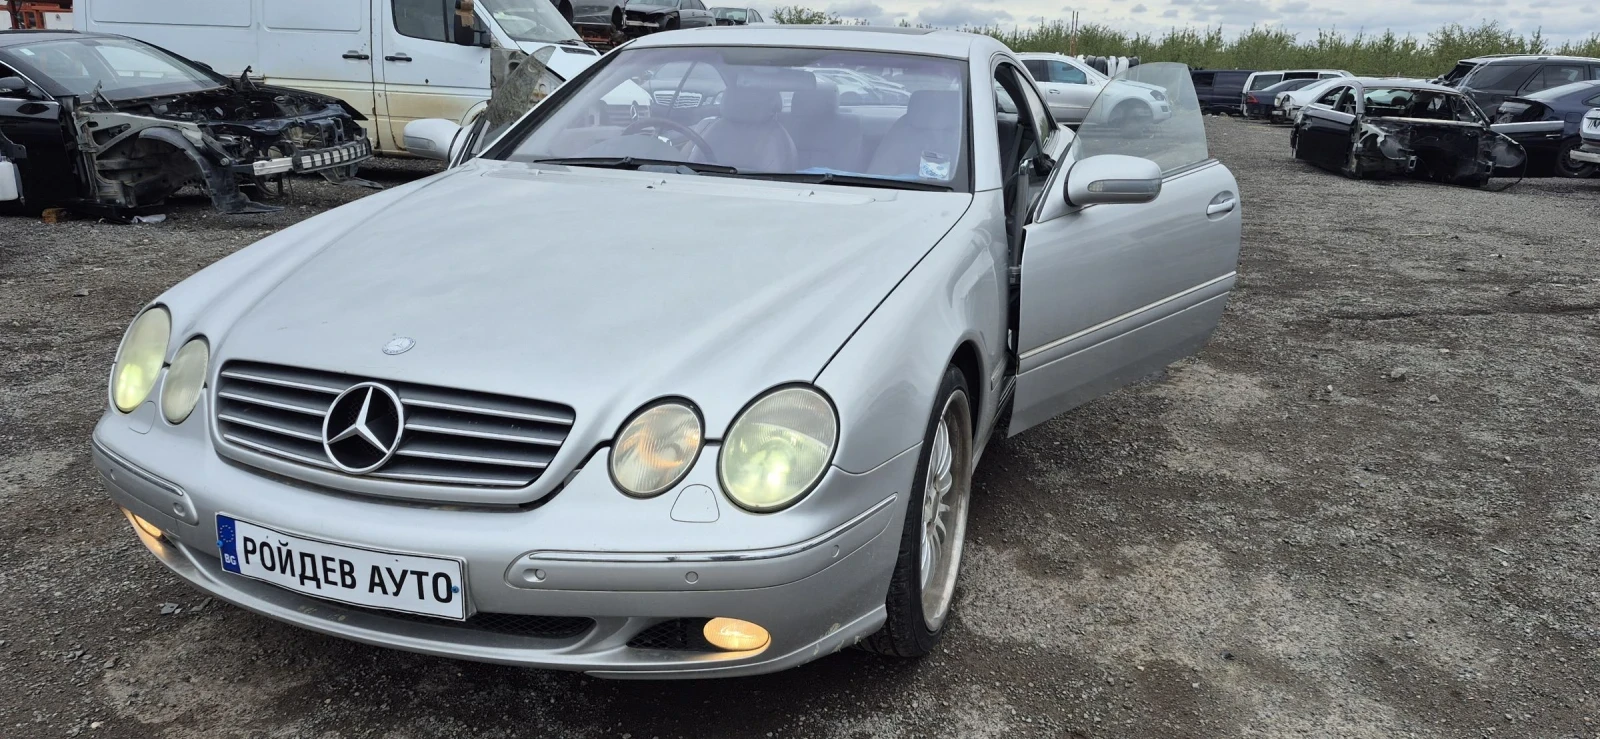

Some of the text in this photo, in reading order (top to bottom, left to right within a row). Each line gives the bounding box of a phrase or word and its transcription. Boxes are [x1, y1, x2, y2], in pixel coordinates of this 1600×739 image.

[224, 553, 237, 566] BG
[243, 536, 453, 603] РОЙДЕВ АУТО
